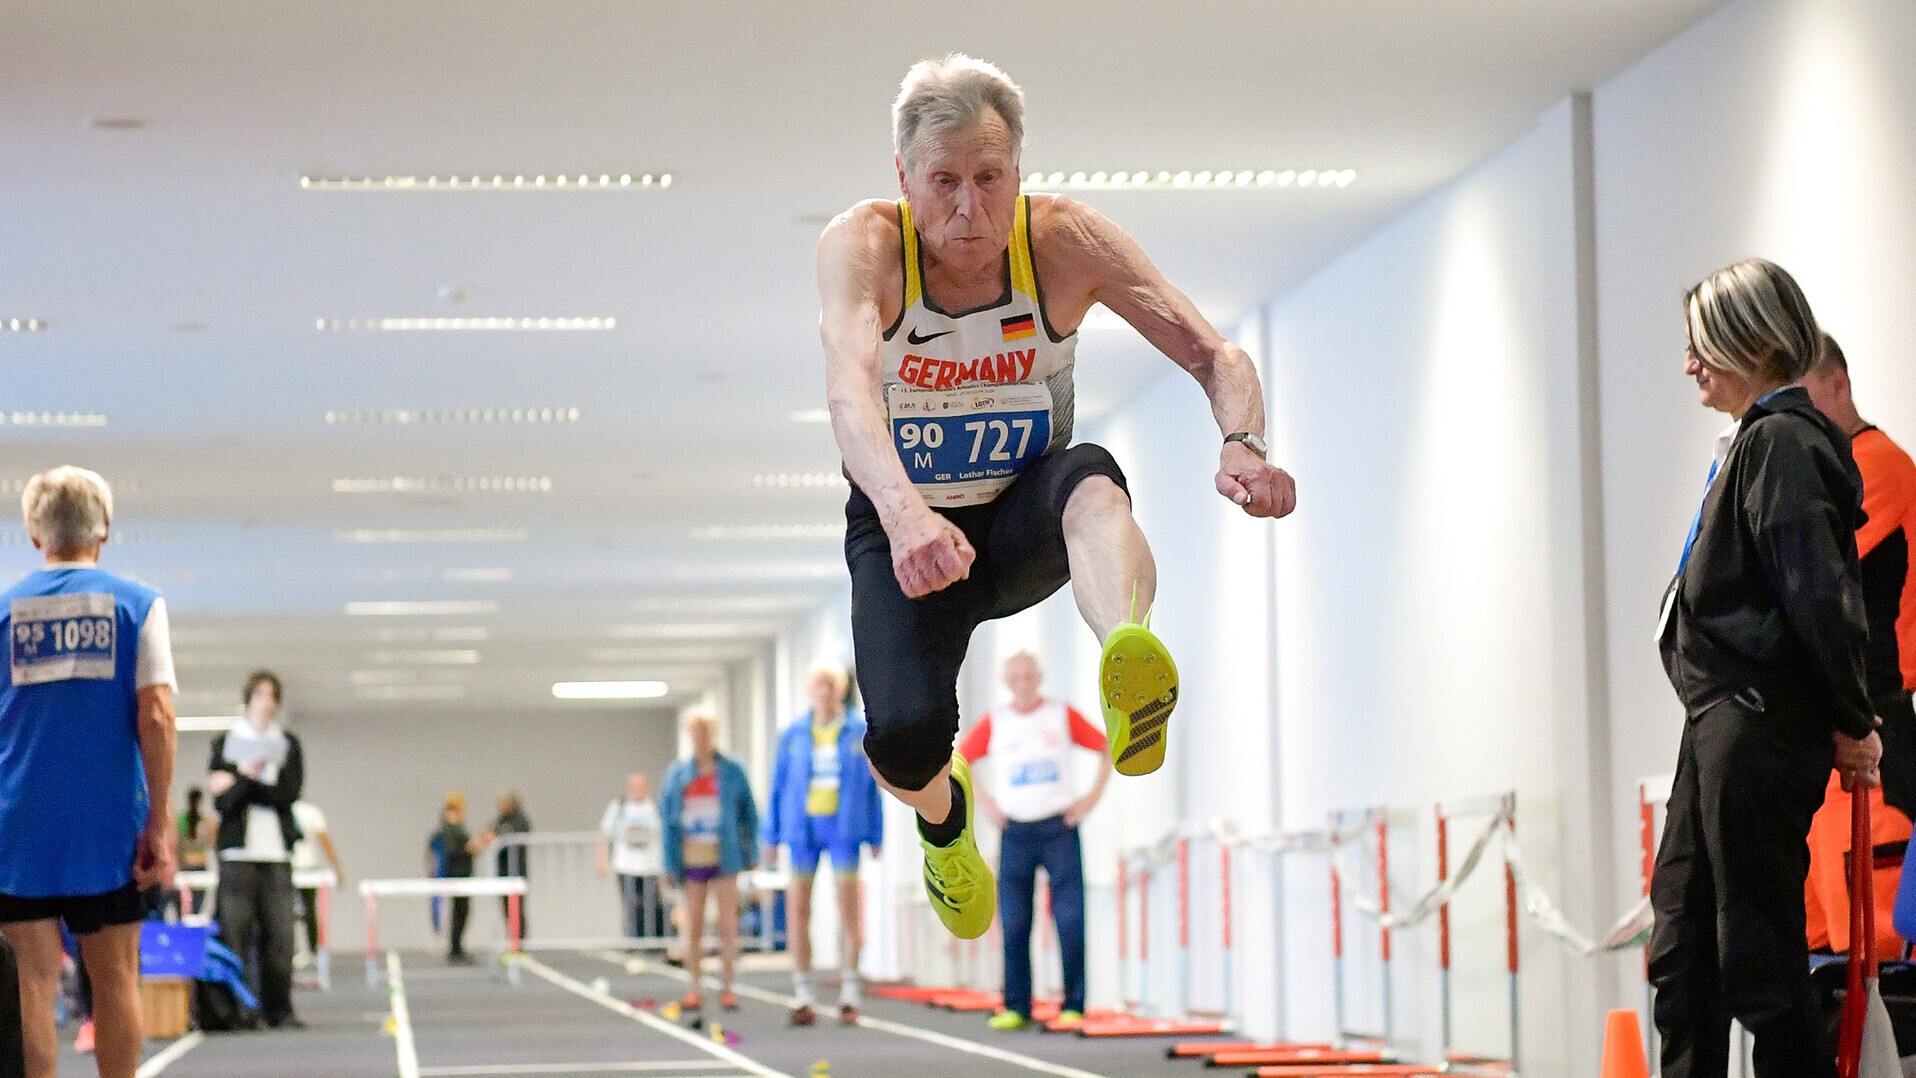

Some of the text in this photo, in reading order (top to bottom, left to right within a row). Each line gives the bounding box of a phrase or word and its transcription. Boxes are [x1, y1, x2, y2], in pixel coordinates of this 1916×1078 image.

[898, 349, 1036, 389] GERMANY
[900, 423, 944, 449] 90
[965, 419, 1033, 463] 727
[915, 453, 933, 469] M
[935, 468, 1013, 481] GER Lothar Fischer
[51, 619, 111, 651] 1098
